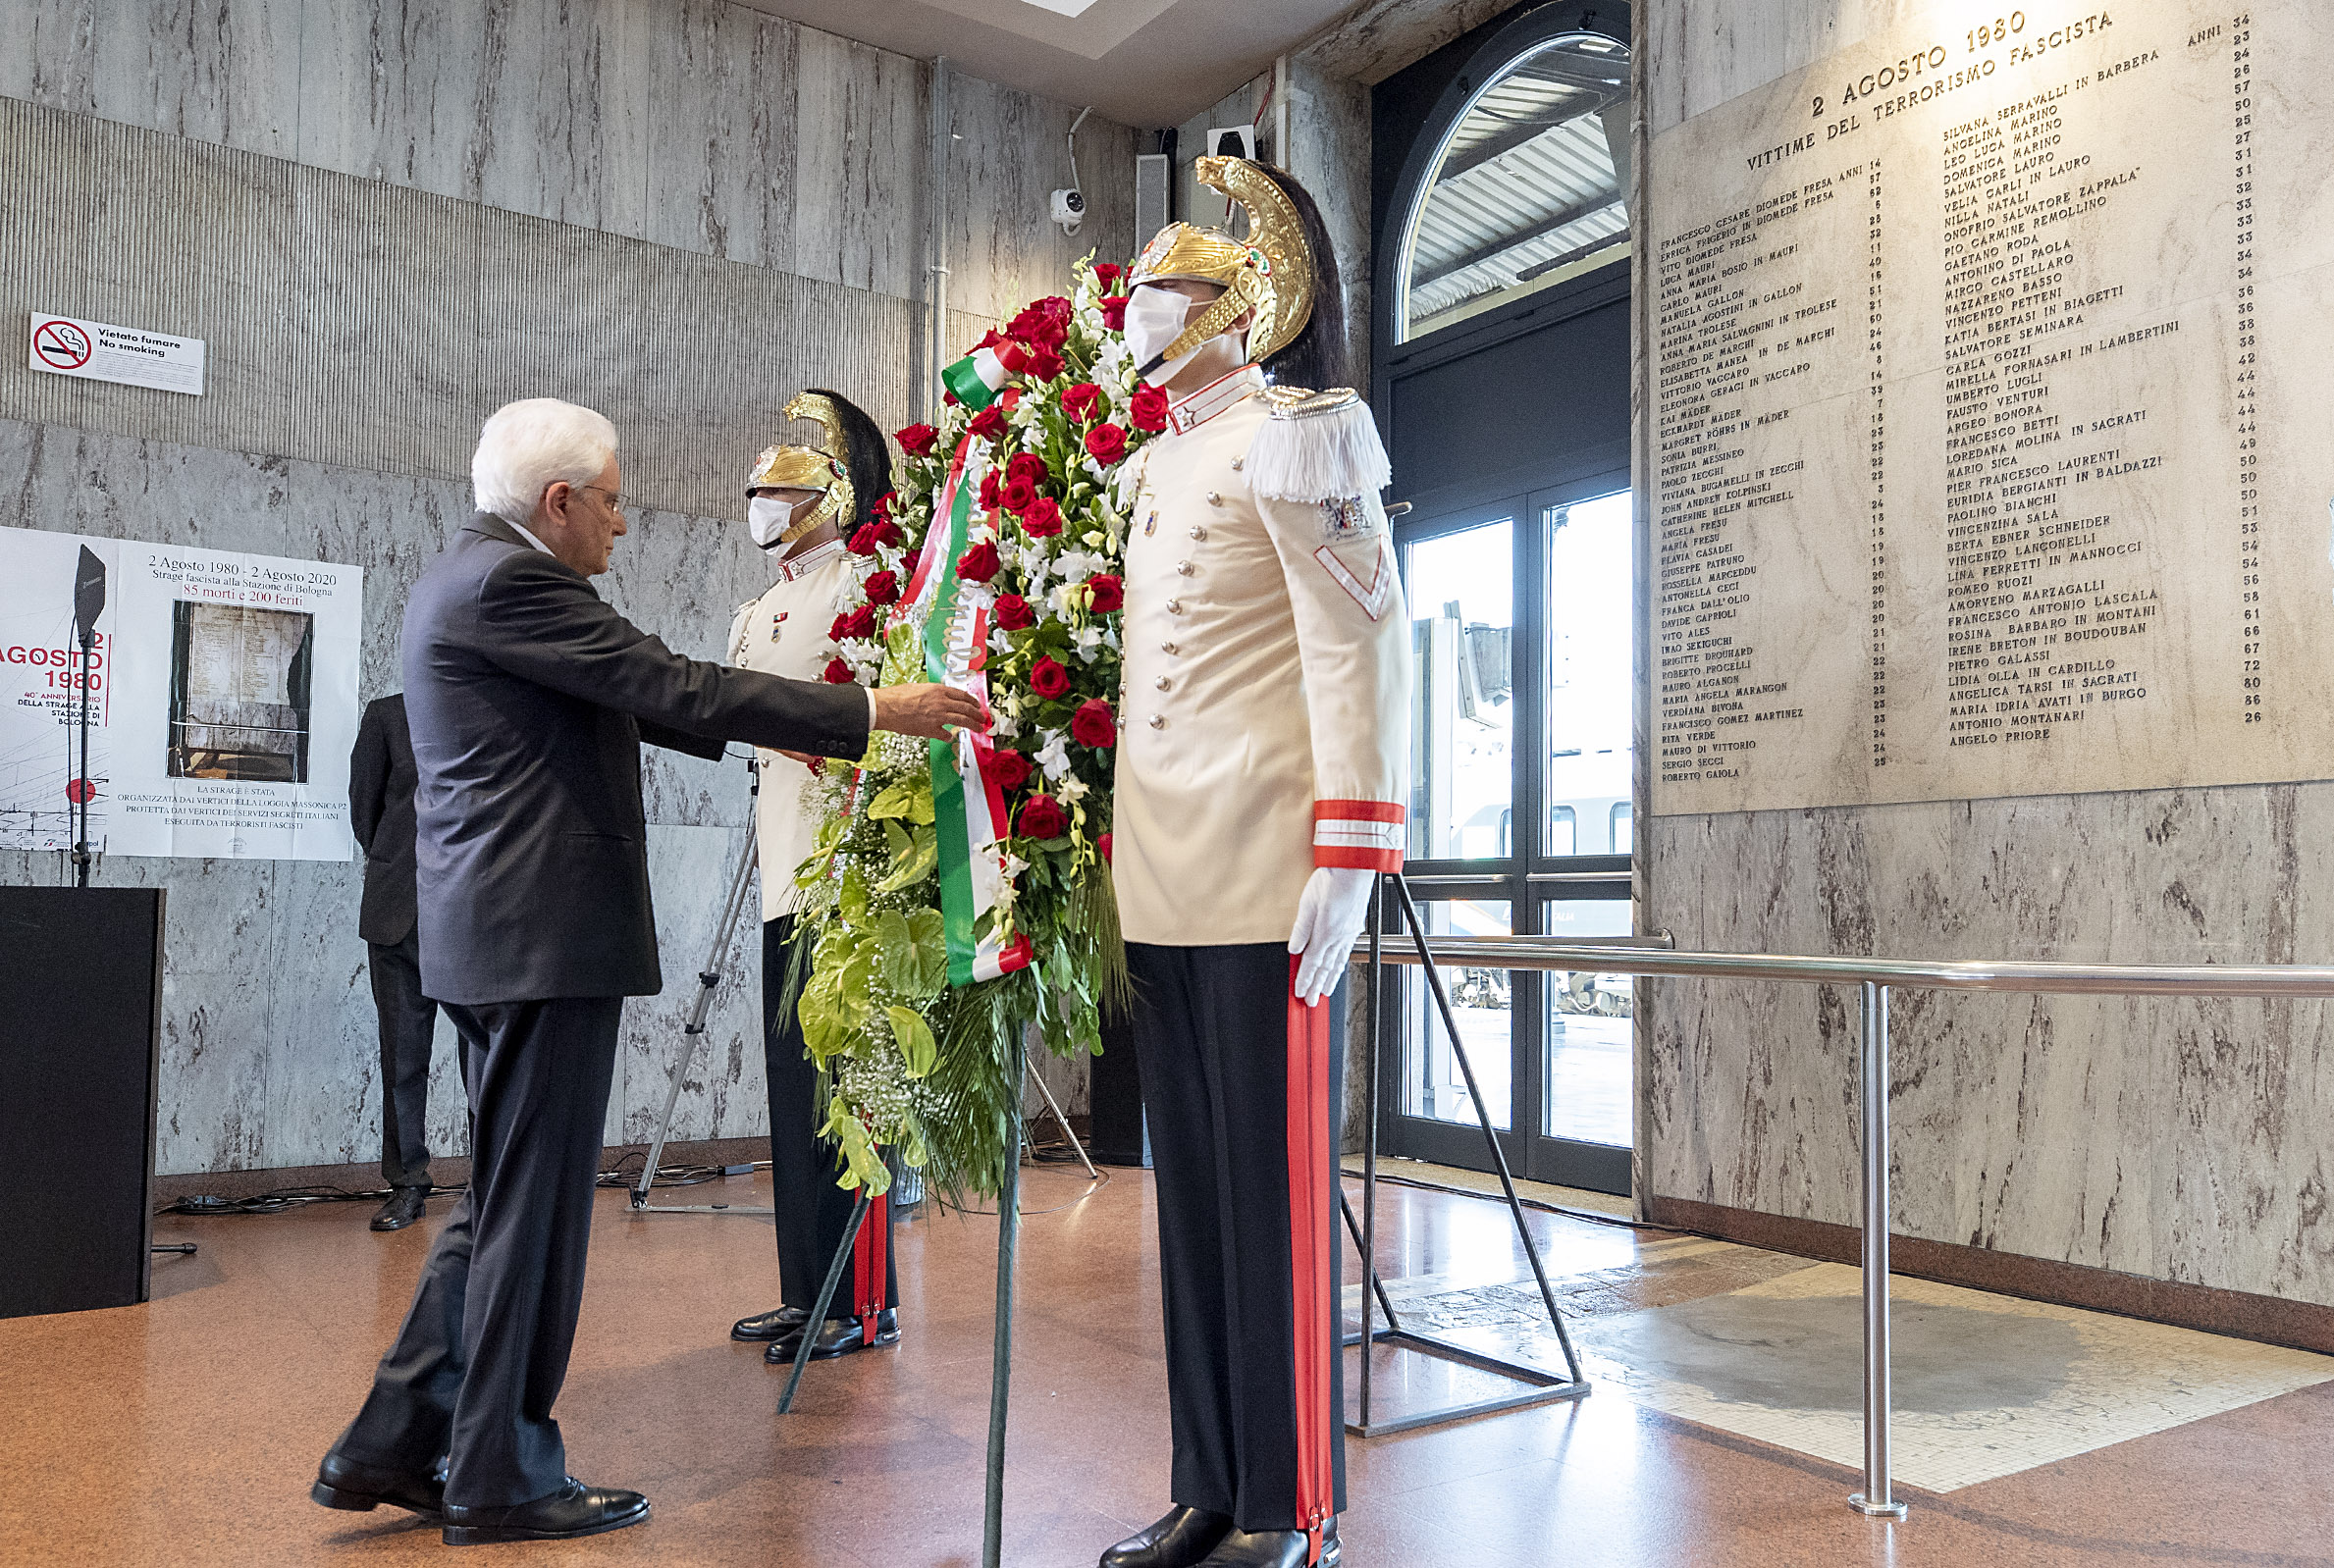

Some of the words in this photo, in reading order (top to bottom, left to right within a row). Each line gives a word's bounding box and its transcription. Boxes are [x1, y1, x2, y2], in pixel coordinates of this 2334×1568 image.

[1747, 132, 1816, 171] VITTIME
[1827, 115, 1861, 140] DEL
[1873, 59, 1995, 122] TERRORISMO
[2009, 10, 2113, 67] FASCISTA
[1812, 96, 1824, 117] 2
[1842, 45, 1946, 104] AGOSTO
[1966, 10, 2026, 53] 1980
[1943, 114, 1989, 142] SILVANA
[1997, 83, 2067, 121] SERRAVALLI
[2075, 76, 2088, 90] IN
[2096, 47, 2158, 82] BARBERA
[2187, 24, 2220, 47] ANNI
[2233, 12, 2250, 29] 34
[1943, 192, 1978, 215] VELIA
[1986, 178, 2021, 200] CARLI
[2030, 170, 2041, 184] IN
[2049, 153, 2090, 178] LAURO
[2235, 96, 2251, 113] 50
[1943, 207, 1979, 229] NILLA
[1987, 189, 2029, 214] NATALI
[2235, 112, 2251, 130] 25
[1944, 245, 1998, 272] GAETANO
[2006, 232, 2038, 252] RODA
[2235, 163, 2252, 179] 31
[1944, 258, 2003, 287] ANTONINO
[2011, 252, 2023, 266] DI
[2031, 237, 2070, 259] PAOLA
[2236, 180, 2252, 195] 32
[1944, 280, 1983, 301] MIRCO
[1990, 252, 2073, 287] CASTELLARO
[2236, 196, 2252, 212] 33
[1660, 332, 1692, 350] MARINA
[1698, 317, 1735, 338] TROLESE
[1870, 270, 1882, 282] 16
[1943, 326, 1979, 345] KATIA
[1987, 309, 2036, 334] BERTASI
[2043, 303, 2056, 317] IN
[2063, 285, 2123, 312] BIAGETTI
[2237, 247, 2252, 263] 34
[1944, 333, 2010, 360] SALVATORE
[2019, 312, 2083, 340] SEMINARA
[2238, 265, 2253, 280] 34
[98, 328, 138, 342] Vietato
[141, 335, 182, 349] fumare
[99, 339, 116, 348] No
[118, 341, 165, 358] smoking
[1661, 381, 1701, 400] VITTORIO
[1706, 366, 1749, 387] VACCARO
[1869, 326, 1882, 339] 24
[1945, 368, 1995, 391] MIRELLA
[2004, 348, 2071, 376] FORNASARI
[2080, 342, 2092, 356] IN
[2099, 320, 2178, 351] LAMBERTINI
[2238, 300, 2254, 315] 36
[1660, 392, 1704, 413] ELEONORA
[1710, 381, 1743, 398] GERACI
[1749, 376, 1758, 388] IN
[1764, 361, 1810, 383] VACCARO
[1869, 340, 1882, 353] 46
[1946, 400, 1988, 420] FAUSTO
[1996, 385, 2048, 407] VENTURI
[2239, 334, 2254, 347] 38
[1946, 442, 2006, 465] LOREDANA
[2015, 430, 2060, 449] MOLINA
[2071, 425, 2083, 437] IN
[2092, 410, 2146, 433] SACRATI
[2237, 386, 2254, 400] 44
[1946, 479, 1971, 494] PIER
[1979, 463, 2049, 487] FRANCESCO
[2058, 447, 2119, 471] LAURENTI
[2238, 419, 2255, 434] 44
[1947, 515, 2018, 538] VINCENZINA
[2027, 508, 2058, 523] SALA
[2240, 470, 2256, 484] 50
[148, 554, 156, 566] 2
[160, 556, 205, 572] Agosto
[210, 561, 239, 575] 1980
[251, 566, 259, 578] 2
[262, 568, 305, 583] Agosto
[308, 572, 337, 586] 2020
[152, 569, 184, 582] Strage
[186, 572, 221, 585] fascista
[224, 577, 240, 587] alla
[243, 579, 282, 591] Stazione
[284, 583, 292, 593] di
[295, 585, 333, 598] Bologna
[184, 584, 198, 596] 85
[202, 587, 236, 600] morti
[249, 591, 272, 602] 200
[275, 593, 303, 605] feriti
[1947, 581, 1989, 597] ROMEO
[1996, 574, 2032, 590] RUOZI
[2242, 539, 2258, 551] 54
[1662, 630, 1682, 642] VITO
[1687, 626, 1710, 638] ALES
[1872, 599, 1883, 609] 20
[1947, 656, 1989, 671] PIETRO
[1997, 650, 2049, 665] GALASSI
[2244, 624, 2259, 637] 66
[1948, 627, 1990, 642] ROSINA
[2008, 617, 2066, 634] BARBARO
[2075, 614, 2086, 625] IN
[2095, 604, 2154, 622] MONTANI
[2243, 591, 2258, 603] 58
[0, 646, 103, 670] GOSTO
[45, 670, 102, 691] 1980
[1948, 673, 1980, 687] LIDIA
[1988, 669, 2019, 682] OLLA
[2028, 666, 2040, 678] IN
[2047, 657, 2115, 675] CARDILLO
[2244, 642, 2259, 654] 67
[1662, 734, 1679, 744] RITA
[1686, 730, 1715, 741] VERDE
[1874, 713, 1885, 723] 23
[1662, 746, 1691, 756] MAURO
[1697, 744, 1706, 753] DI
[1712, 740, 1756, 752] VITTORIO
[1873, 727, 1884, 738] 24
[1949, 733, 1997, 747] ANGELO
[2005, 728, 2049, 742] PRIORE
[2245, 710, 2261, 723] 26
